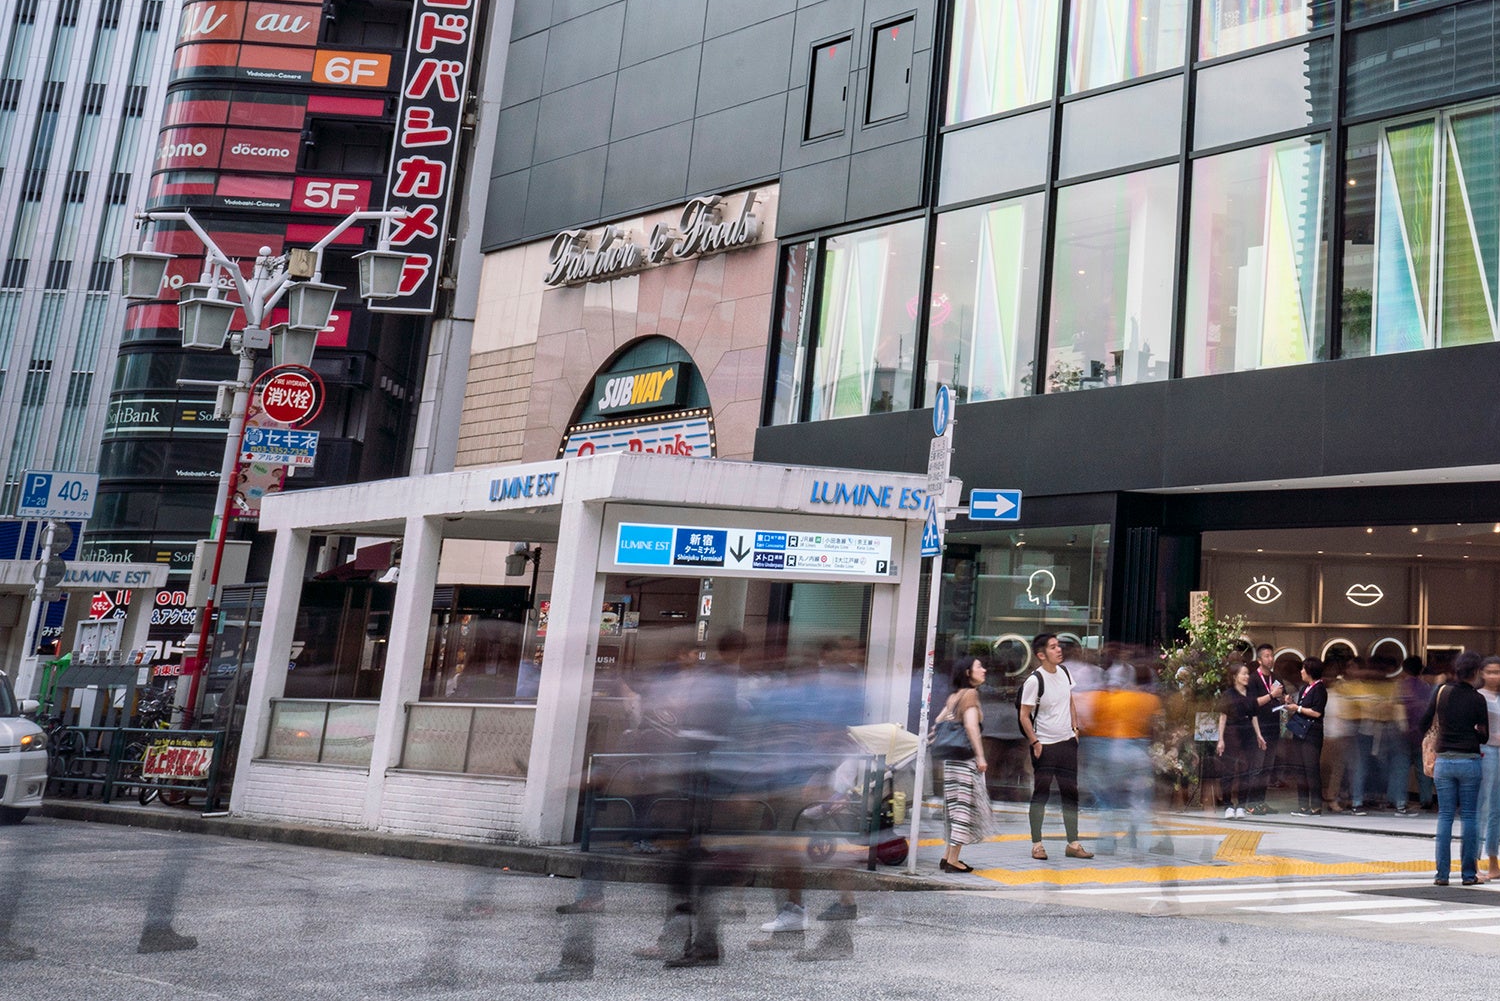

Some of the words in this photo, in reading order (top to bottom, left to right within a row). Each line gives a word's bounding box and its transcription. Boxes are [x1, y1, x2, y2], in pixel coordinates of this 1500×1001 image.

[255, 13, 311, 33] au
[324, 57, 379, 84] 6F
[231, 143, 290, 158] docomo
[304, 181, 360, 209] 5F
[544, 227, 646, 286] Fashion
[673, 190, 758, 258] Foods
[266, 386, 311, 410] 消火栓
[598, 368, 675, 411] SUBWAY
[265, 430, 317, 449] セキネ
[31, 476, 47, 495] P
[58, 480, 89, 502] 40分
[489, 475, 534, 502] LUMINE
[535, 472, 561, 496] EST
[810, 480, 894, 509] LUMINE
[621, 539, 653, 551] LUMINE
[655, 541, 670, 551] EST
[690, 533, 714, 546] 新宿
[677, 554, 700, 562] Shinjuku
[684, 545, 717, 555] ターミナル
[878, 561, 885, 572] P
[63, 569, 121, 584] LUMINE
[125, 571, 150, 584] EST
